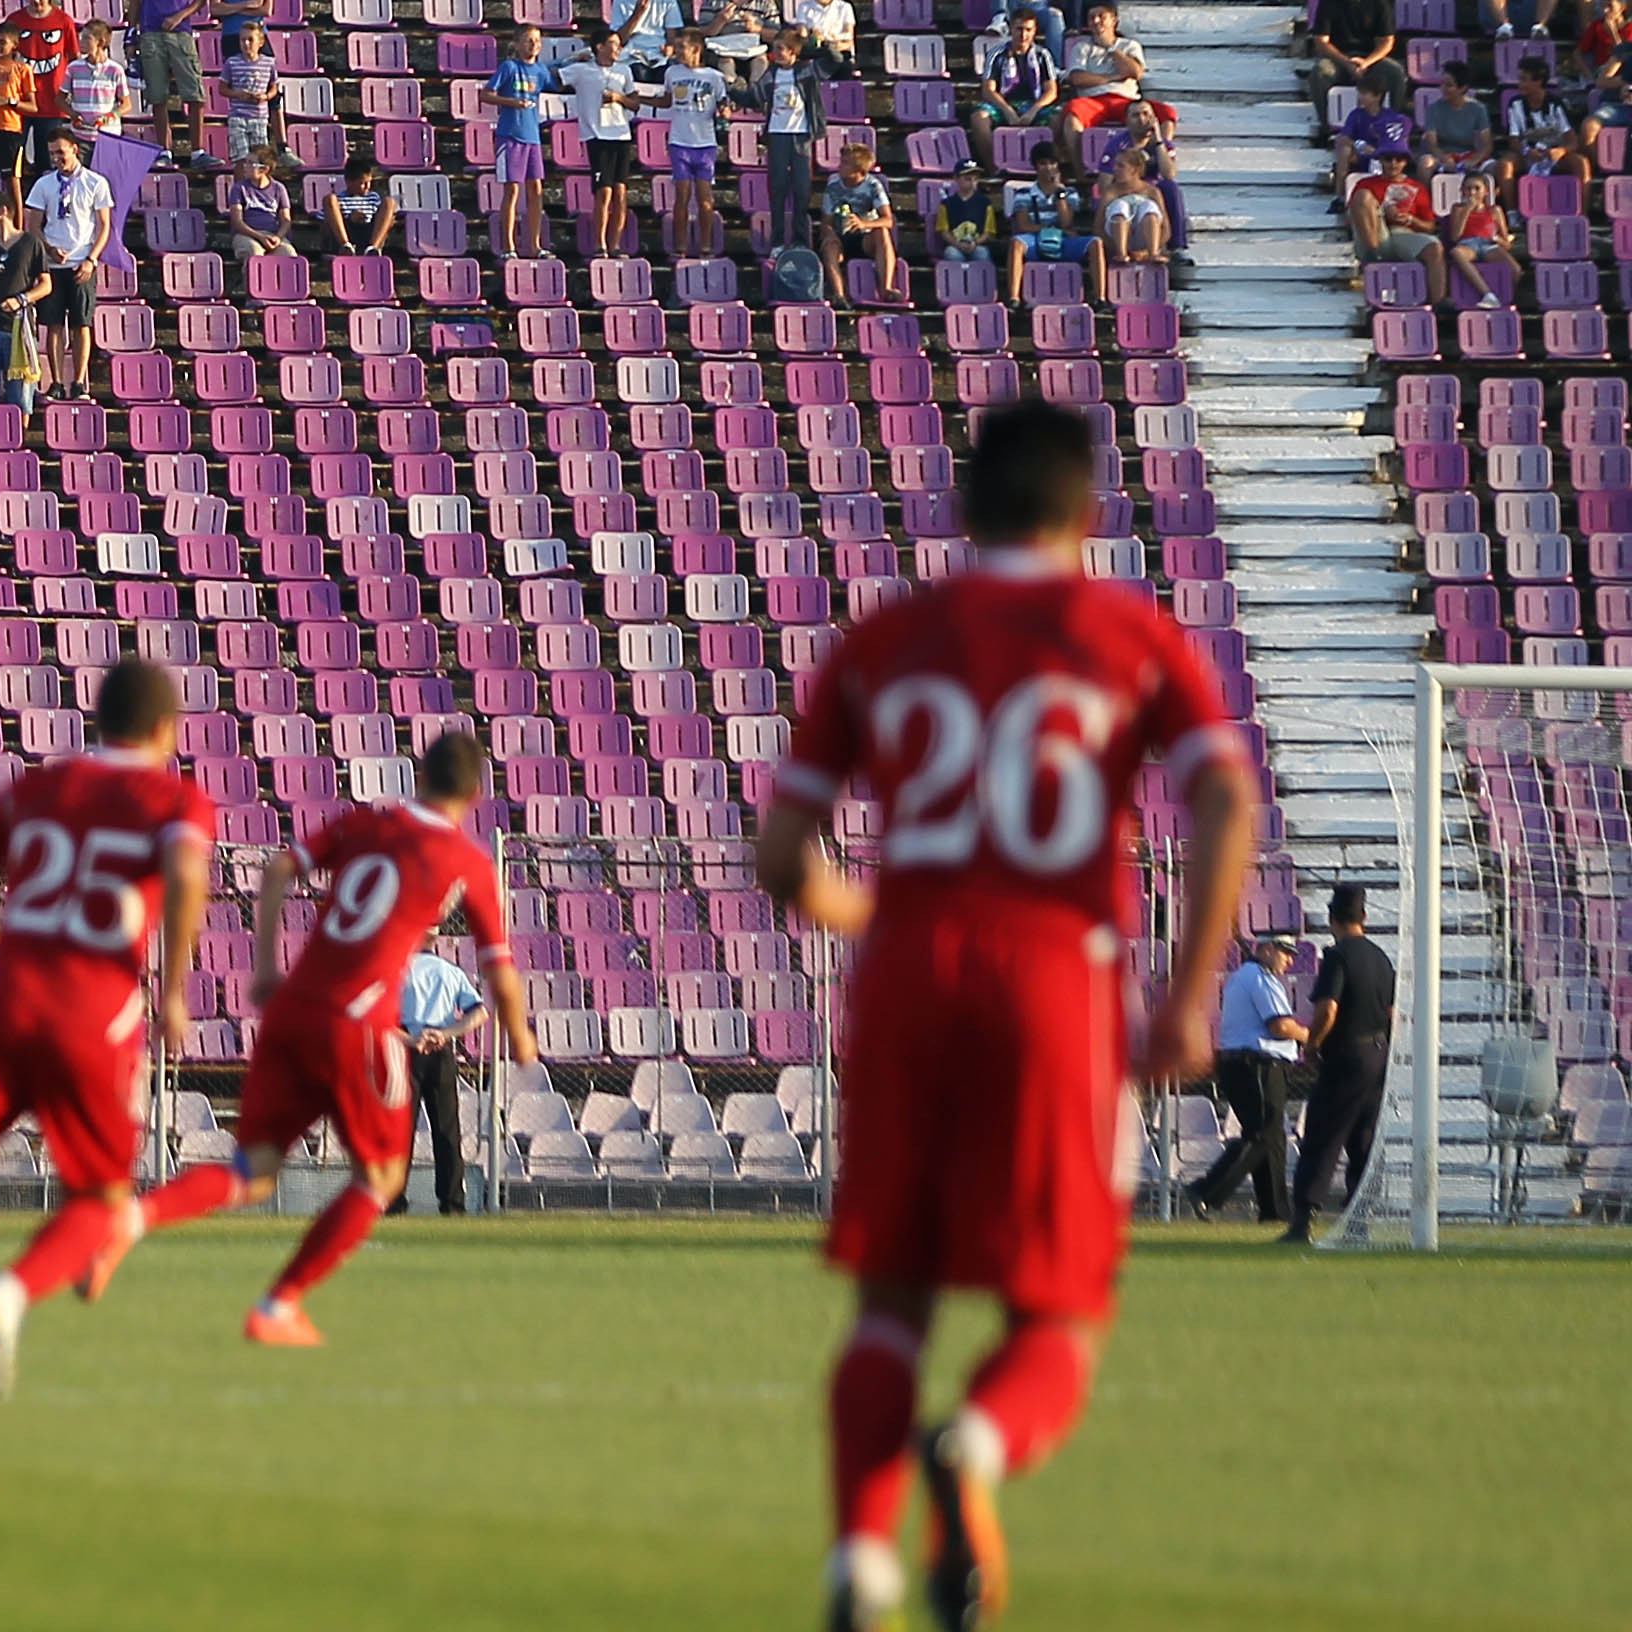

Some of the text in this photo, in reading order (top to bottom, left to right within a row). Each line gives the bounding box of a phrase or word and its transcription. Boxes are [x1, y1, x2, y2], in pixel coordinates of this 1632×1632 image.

[871, 673, 1109, 876] 26
[2, 818, 154, 952] 25
[321, 852, 401, 944] 9
